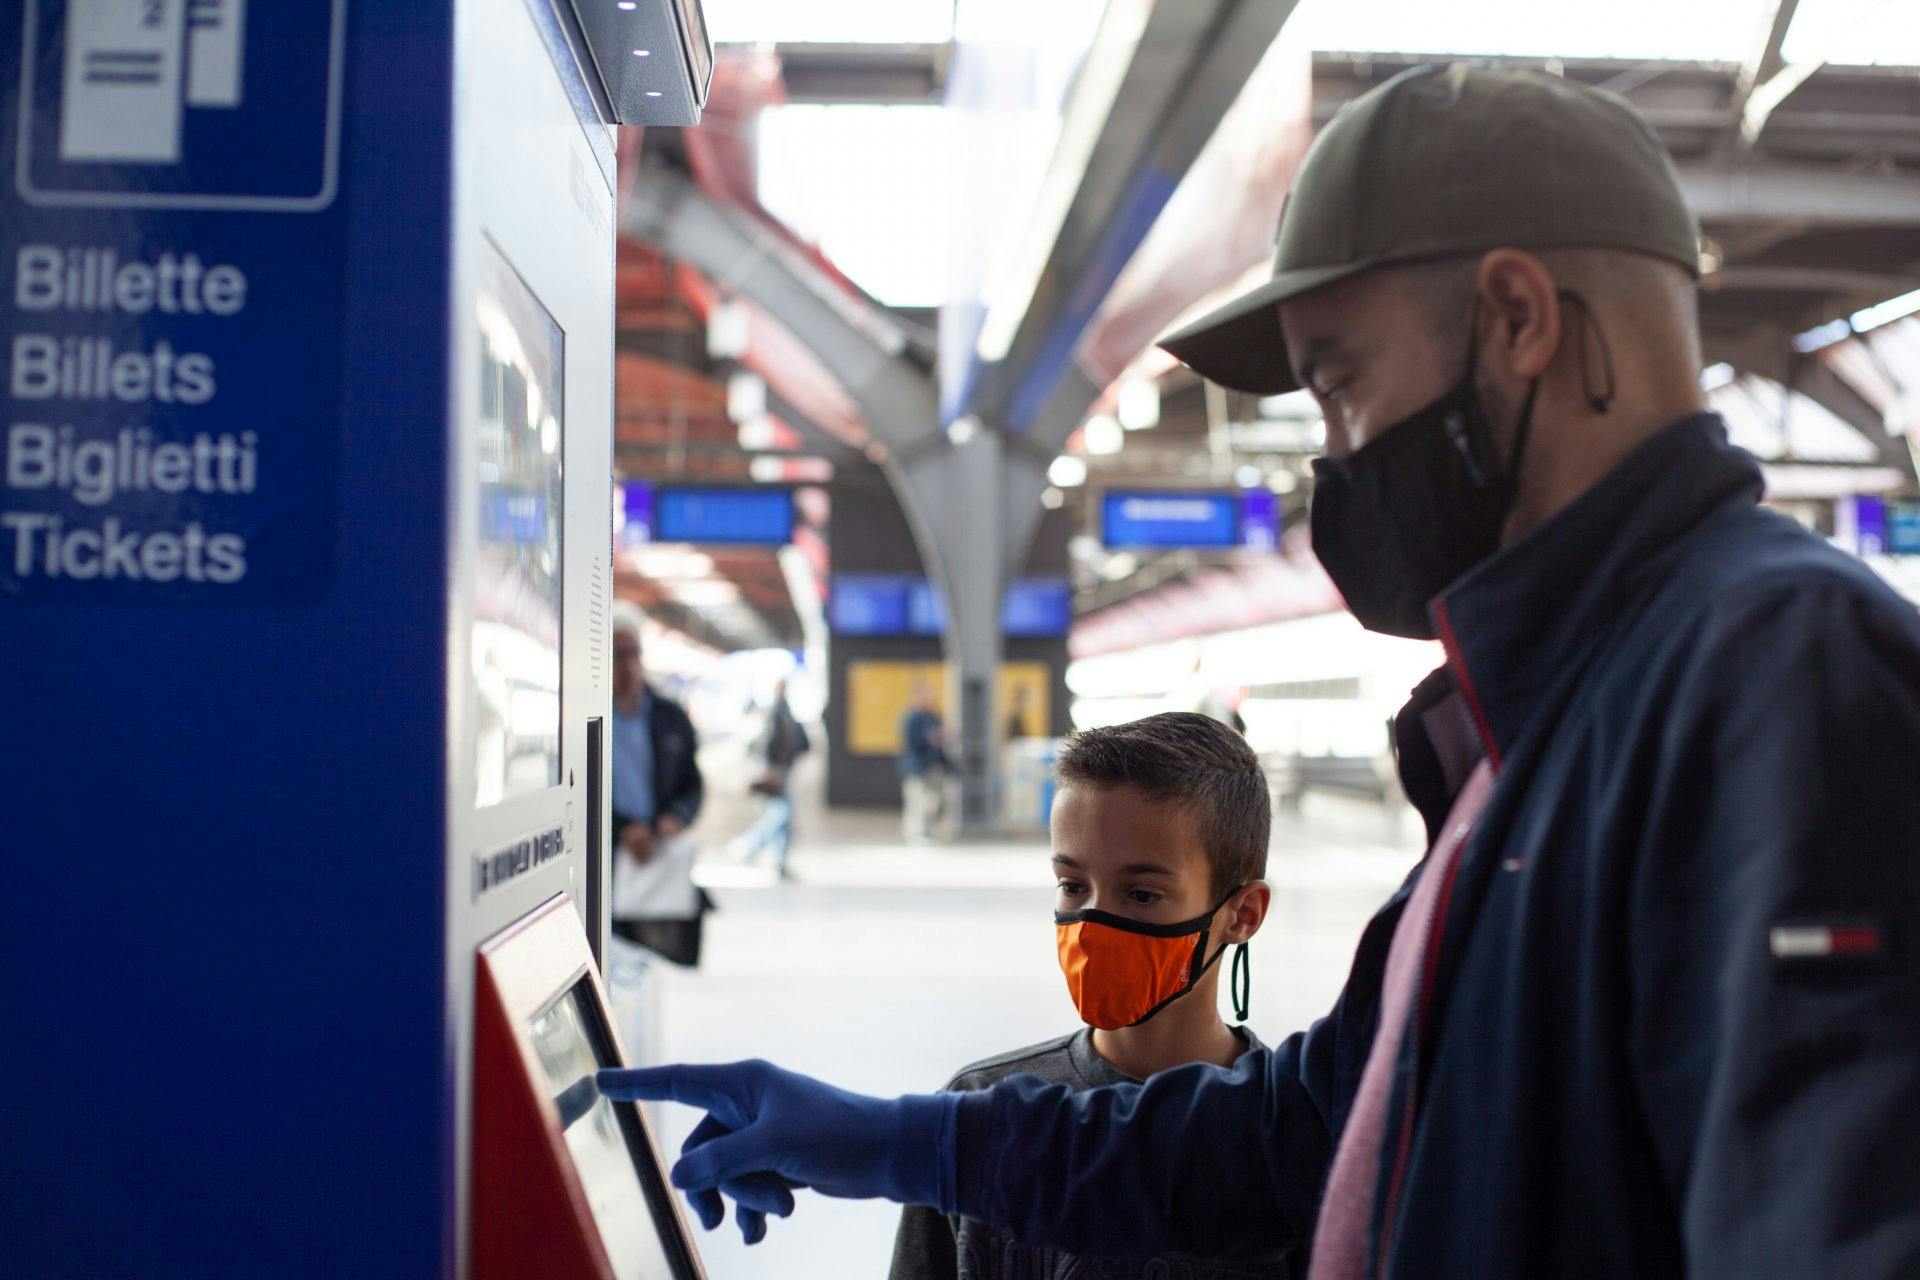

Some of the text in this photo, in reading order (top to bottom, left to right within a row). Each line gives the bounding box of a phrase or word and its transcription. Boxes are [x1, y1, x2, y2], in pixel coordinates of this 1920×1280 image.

[16, 246, 248, 315] Billette
[12, 335, 217, 404] Billets
[6, 424, 258, 506] Biglietti
[1, 511, 248, 584] Tickets
